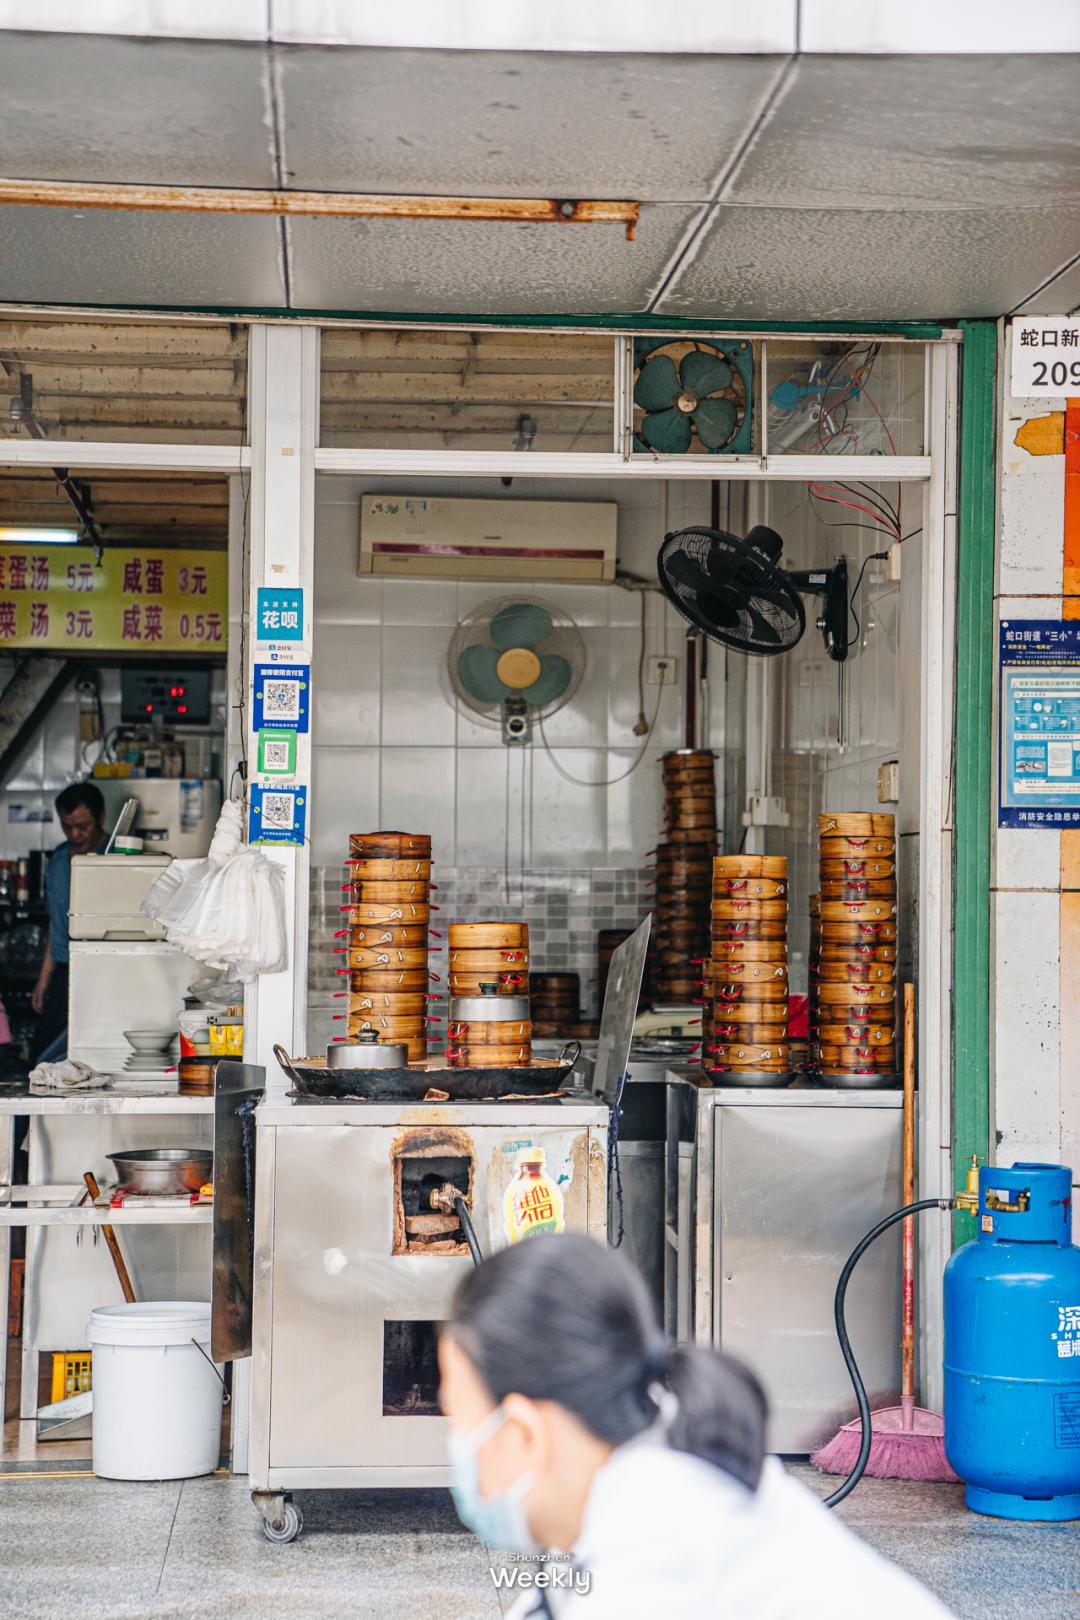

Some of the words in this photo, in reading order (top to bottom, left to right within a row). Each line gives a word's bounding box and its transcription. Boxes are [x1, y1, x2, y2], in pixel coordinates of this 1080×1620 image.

[1020, 328, 1080, 347] 蛇口新
[1032, 361, 1080, 386] 209
[0, 555, 49, 592] 蛋汤
[67, 563, 94, 592] 5元
[122, 557, 164, 594] 咸蛋
[178, 566, 207, 594] 3元
[66, 609, 93, 638] 3元
[122, 604, 163, 641] 咸菜
[179, 612, 222, 641] 0.5元
[262, 610, 298, 629] 花呗
